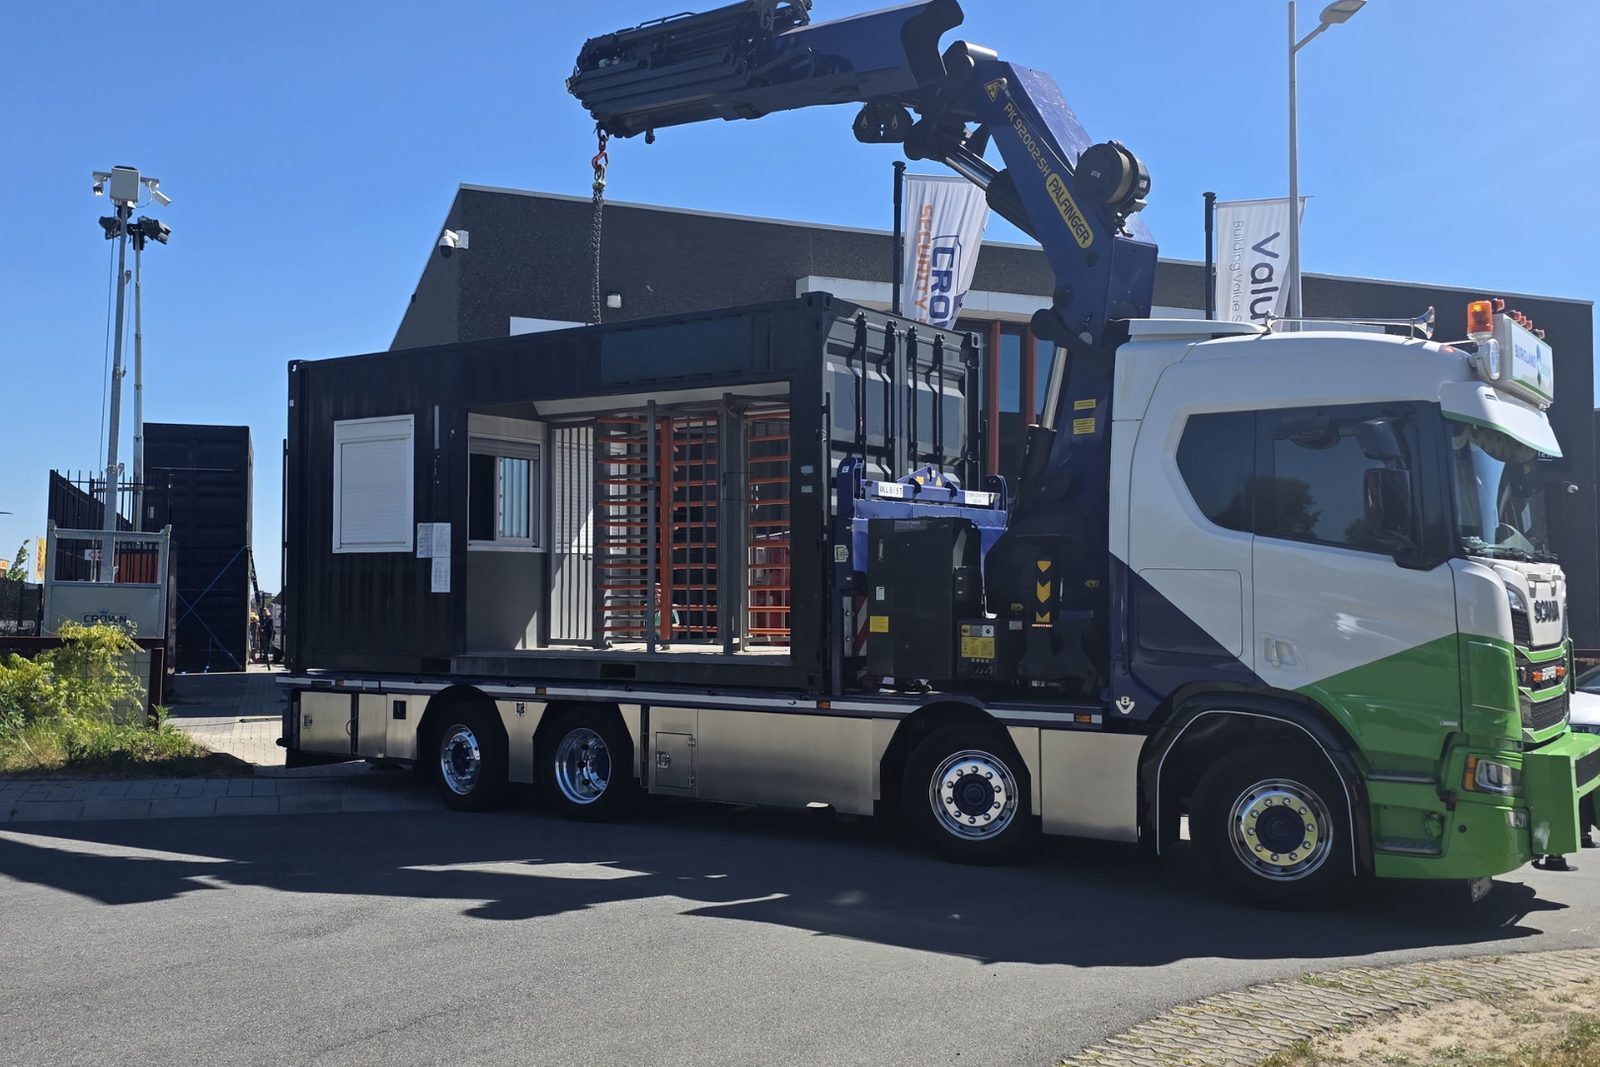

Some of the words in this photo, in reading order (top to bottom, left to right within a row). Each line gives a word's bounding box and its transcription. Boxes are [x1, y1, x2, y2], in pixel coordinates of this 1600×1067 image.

[1004, 102, 1017, 122] PK
[1048, 178, 1091, 245] PALFINGER
[914, 202, 933, 311] SECURITY
[1230, 220, 1244, 272] Building
[929, 246, 955, 328] CRO
[1232, 274, 1243, 312] Value
[83, 614, 128, 624] CROWN
